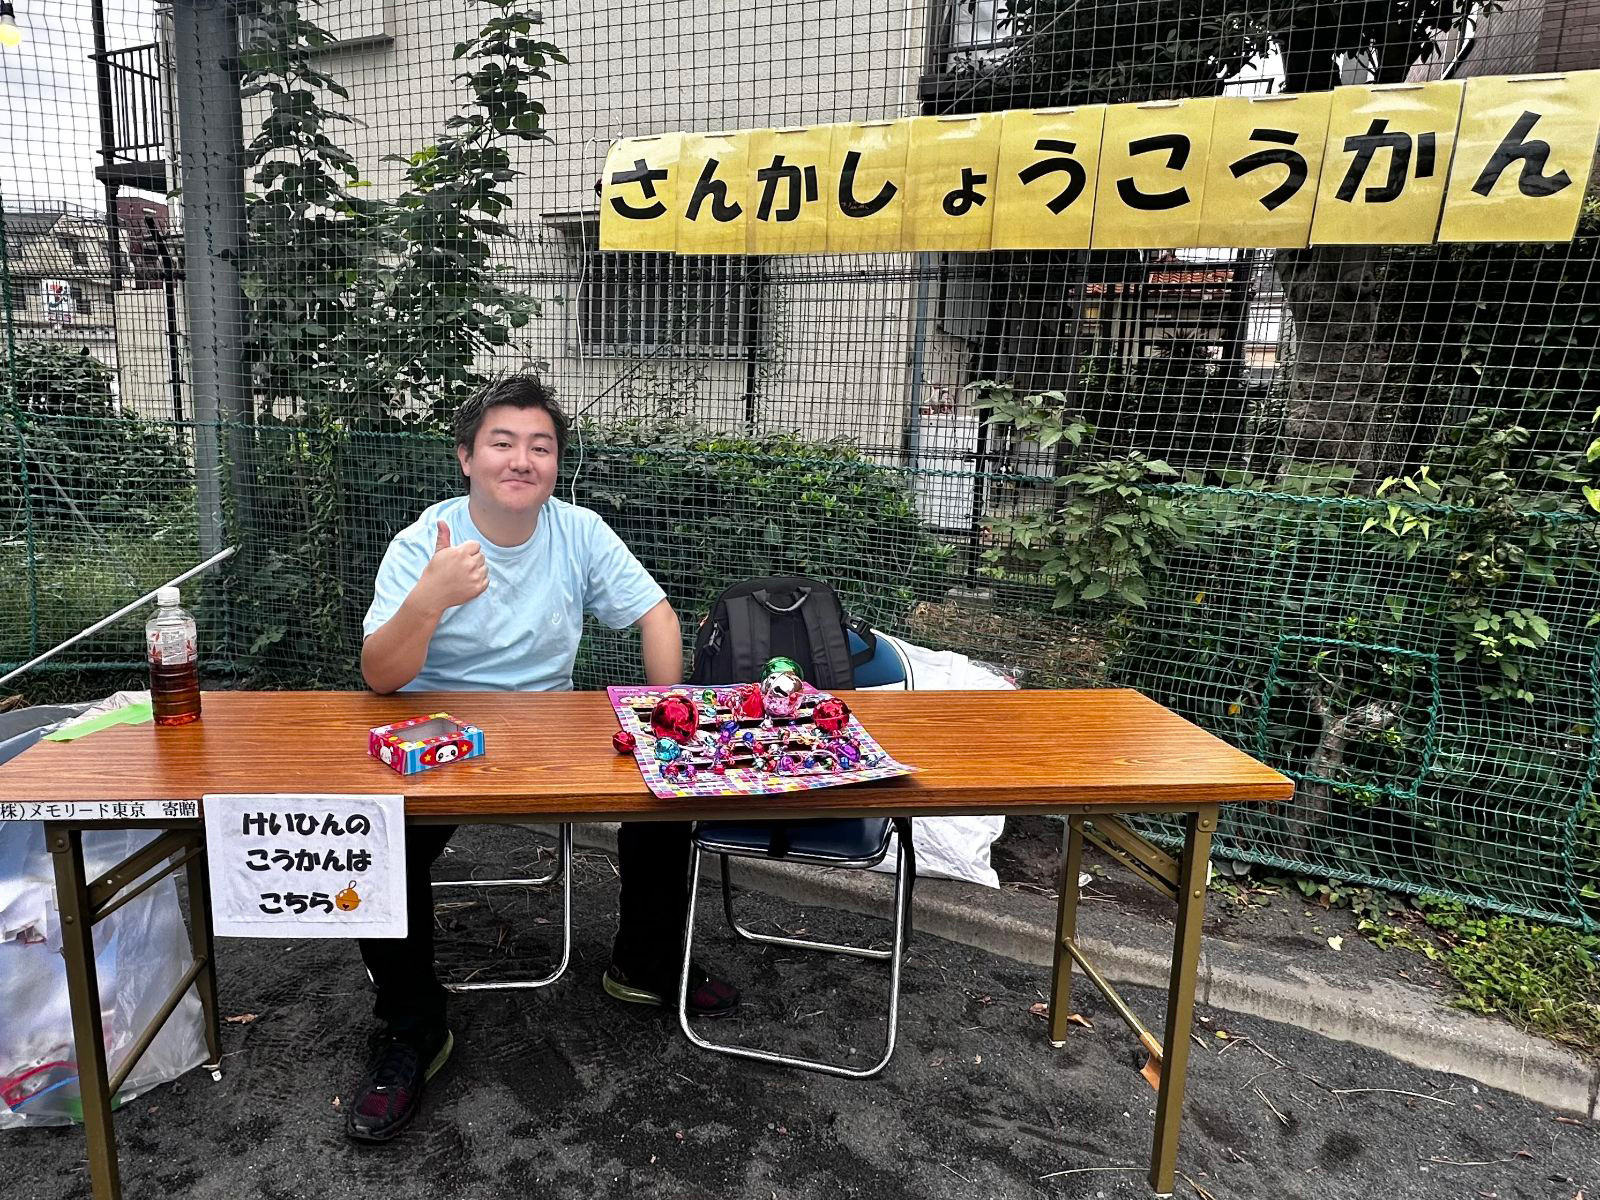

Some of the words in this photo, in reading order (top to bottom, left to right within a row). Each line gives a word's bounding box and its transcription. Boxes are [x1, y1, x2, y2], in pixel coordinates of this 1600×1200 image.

[609, 110, 1573, 222] さんかしょうこうかん
[162, 801, 196, 817] 寄贈
[242, 812, 371, 836] けいひんの
[245, 849, 372, 872] こうかんは
[259, 892, 335, 914] こちら
